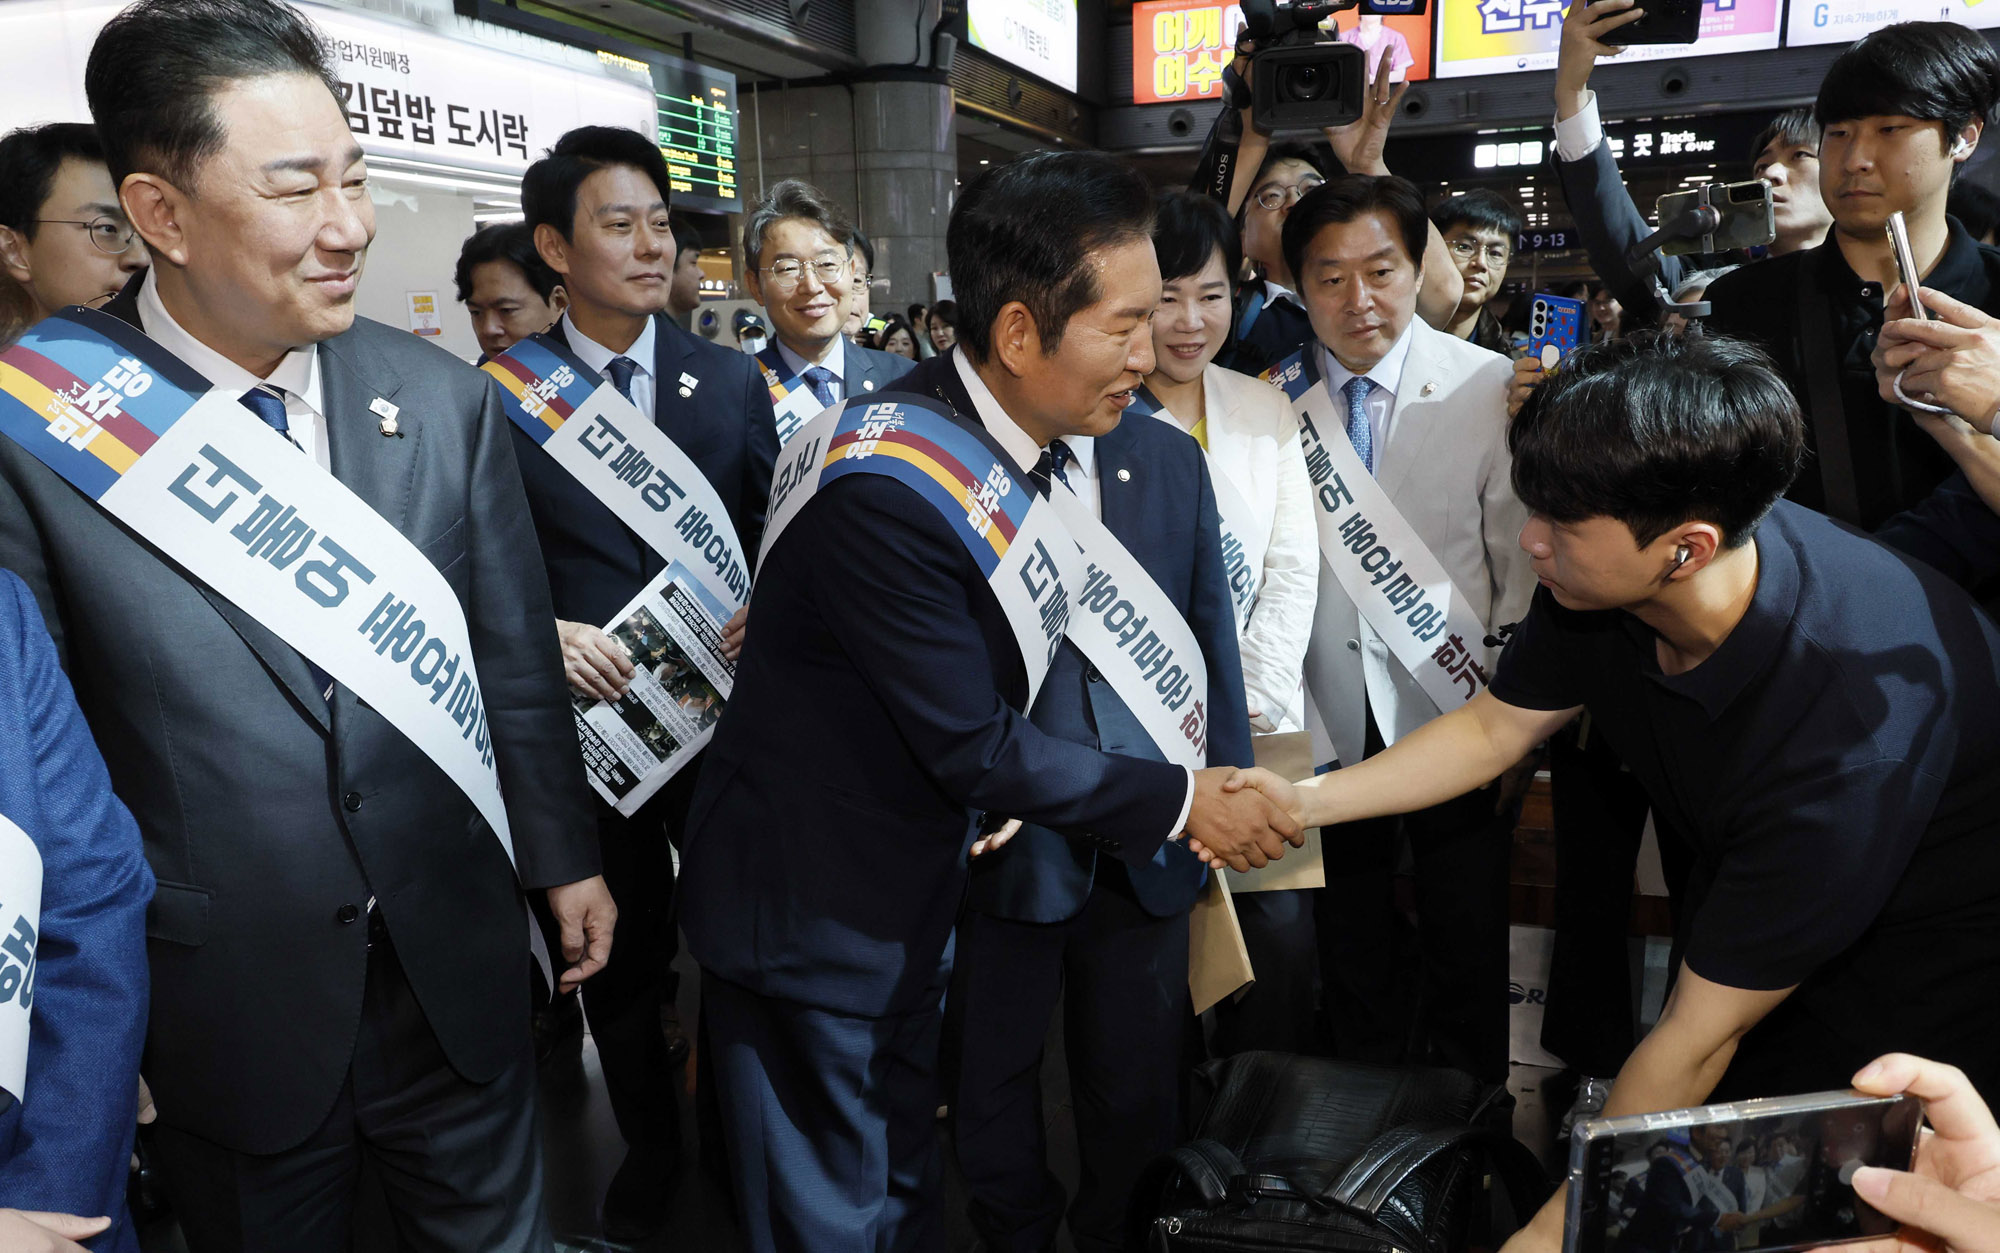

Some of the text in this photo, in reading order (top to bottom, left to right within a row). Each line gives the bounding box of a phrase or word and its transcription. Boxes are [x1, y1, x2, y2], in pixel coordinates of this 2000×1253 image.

[1154, 7, 1222, 53] 어깨
[1833, 8, 1899, 25] 지속가능하게
[1154, 51, 1235, 98] 여수
[447, 103, 529, 160] 도시락
[1633, 133, 1653, 156] 곳
[1661, 130, 1696, 145] Tracks
[1216, 154, 1229, 194] SONY
[1533, 233, 1565, 247] 9-13
[45, 357, 153, 452] 민주당
[519, 365, 575, 419] 민주당
[844, 402, 898, 460] 민주당
[577, 413, 687, 513] 더불어
[167, 443, 376, 608] 더불어
[966, 462, 1011, 539] 민주당
[684, 614, 701, 633] 2026년
[1338, 511, 1447, 643] 풍요로운
[1431, 633, 1489, 701] 한가
[1077, 562, 1192, 713] 풍요로운
